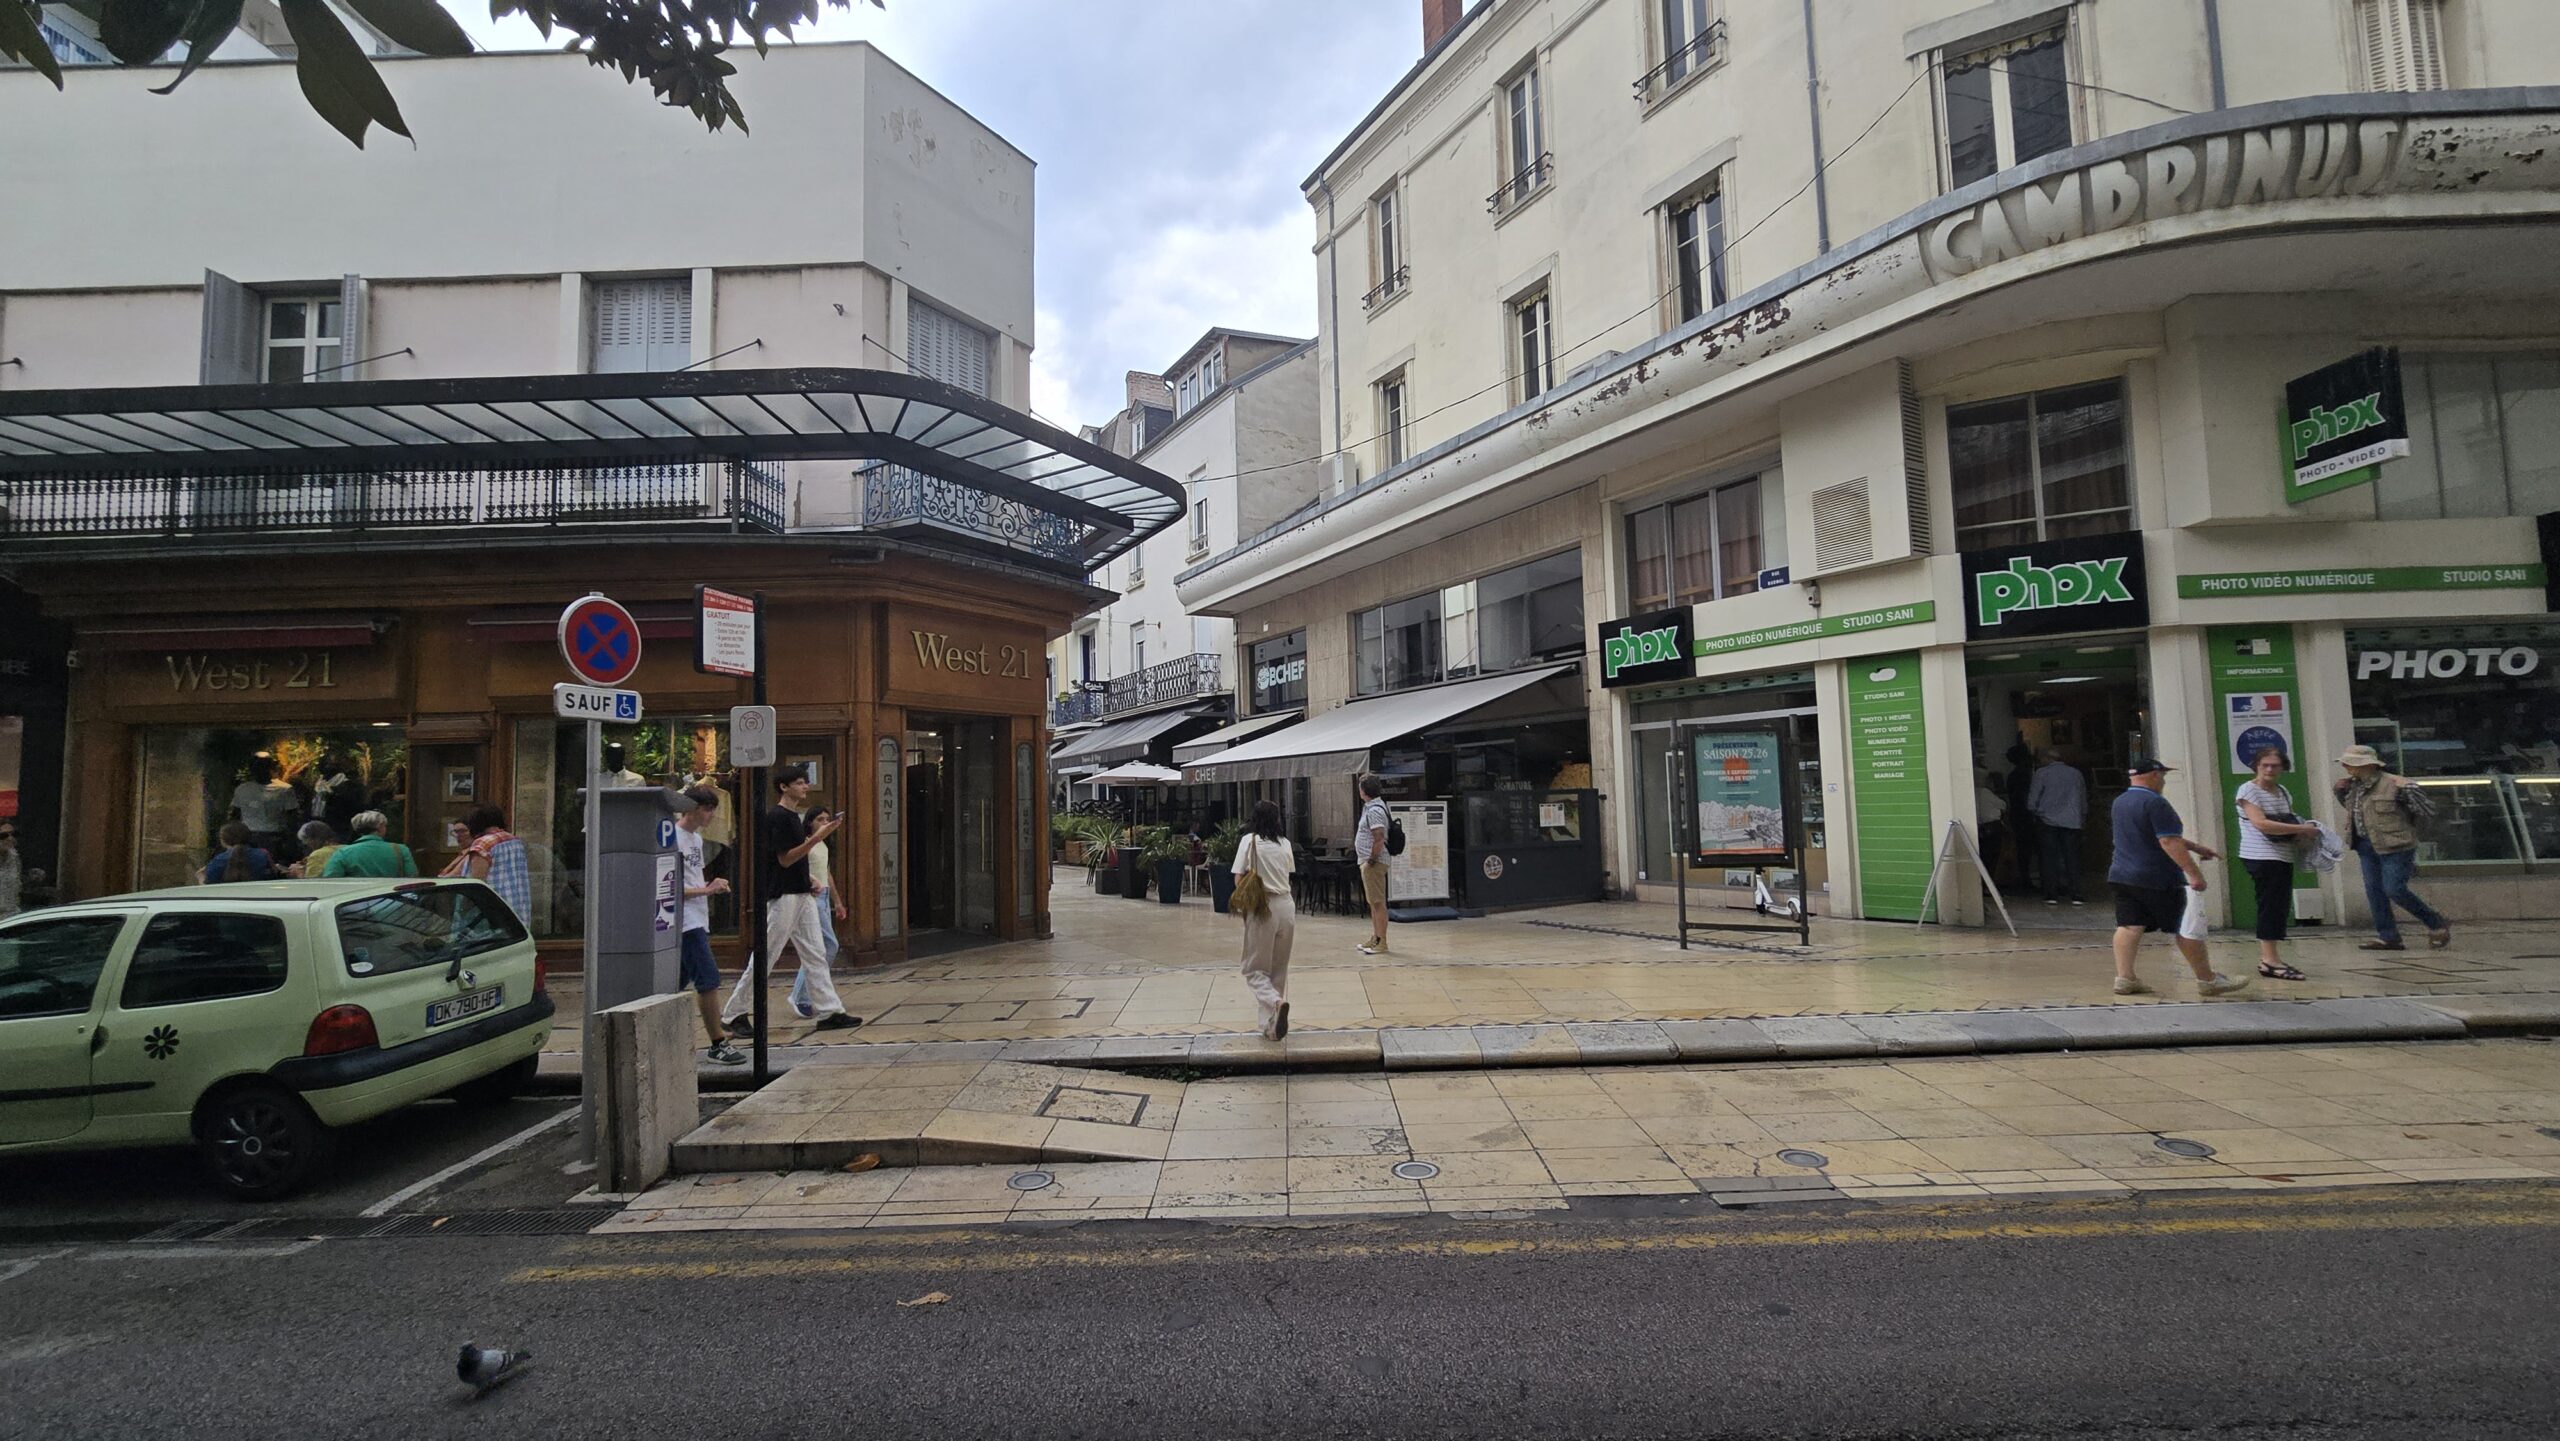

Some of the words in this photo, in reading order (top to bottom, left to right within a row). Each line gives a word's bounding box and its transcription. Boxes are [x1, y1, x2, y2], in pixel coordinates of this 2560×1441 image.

[2292, 392, 2386, 460] phox
[2300, 463, 2336, 480] PHOTO
[1976, 556, 2134, 626] phox
[2201, 578, 2248, 590] PHOTO
[2251, 574, 2290, 588] VIDÉO
[2295, 572, 2375, 587] NUMÉRIQUE
[2443, 571, 2491, 583] STUDIO
[2495, 569, 2528, 582] SANI
[1705, 637, 1735, 651] PHOTO
[1736, 631, 1763, 647] VIDÉO
[1765, 622, 1823, 642] NUMÉRIQUE
[1842, 613, 1884, 629] STUDIO
[1886, 608, 1914, 622] SANI
[911, 631, 991, 675] West
[1001, 644, 1032, 680] 21
[1605, 626, 1682, 678] phox
[2357, 646, 2539, 680] PHOTO
[166, 655, 270, 691] West
[286, 652, 336, 688] 21
[2227, 667, 2284, 675] INFORMATIONS
[565, 693, 611, 712] SAUF
[1864, 692, 1888, 700] STUDIO
[1703, 749, 1739, 760] SAISON
[883, 773, 893, 821] GANT
[662, 820, 674, 848] P
[435, 990, 495, 1021] DK-790-HF
